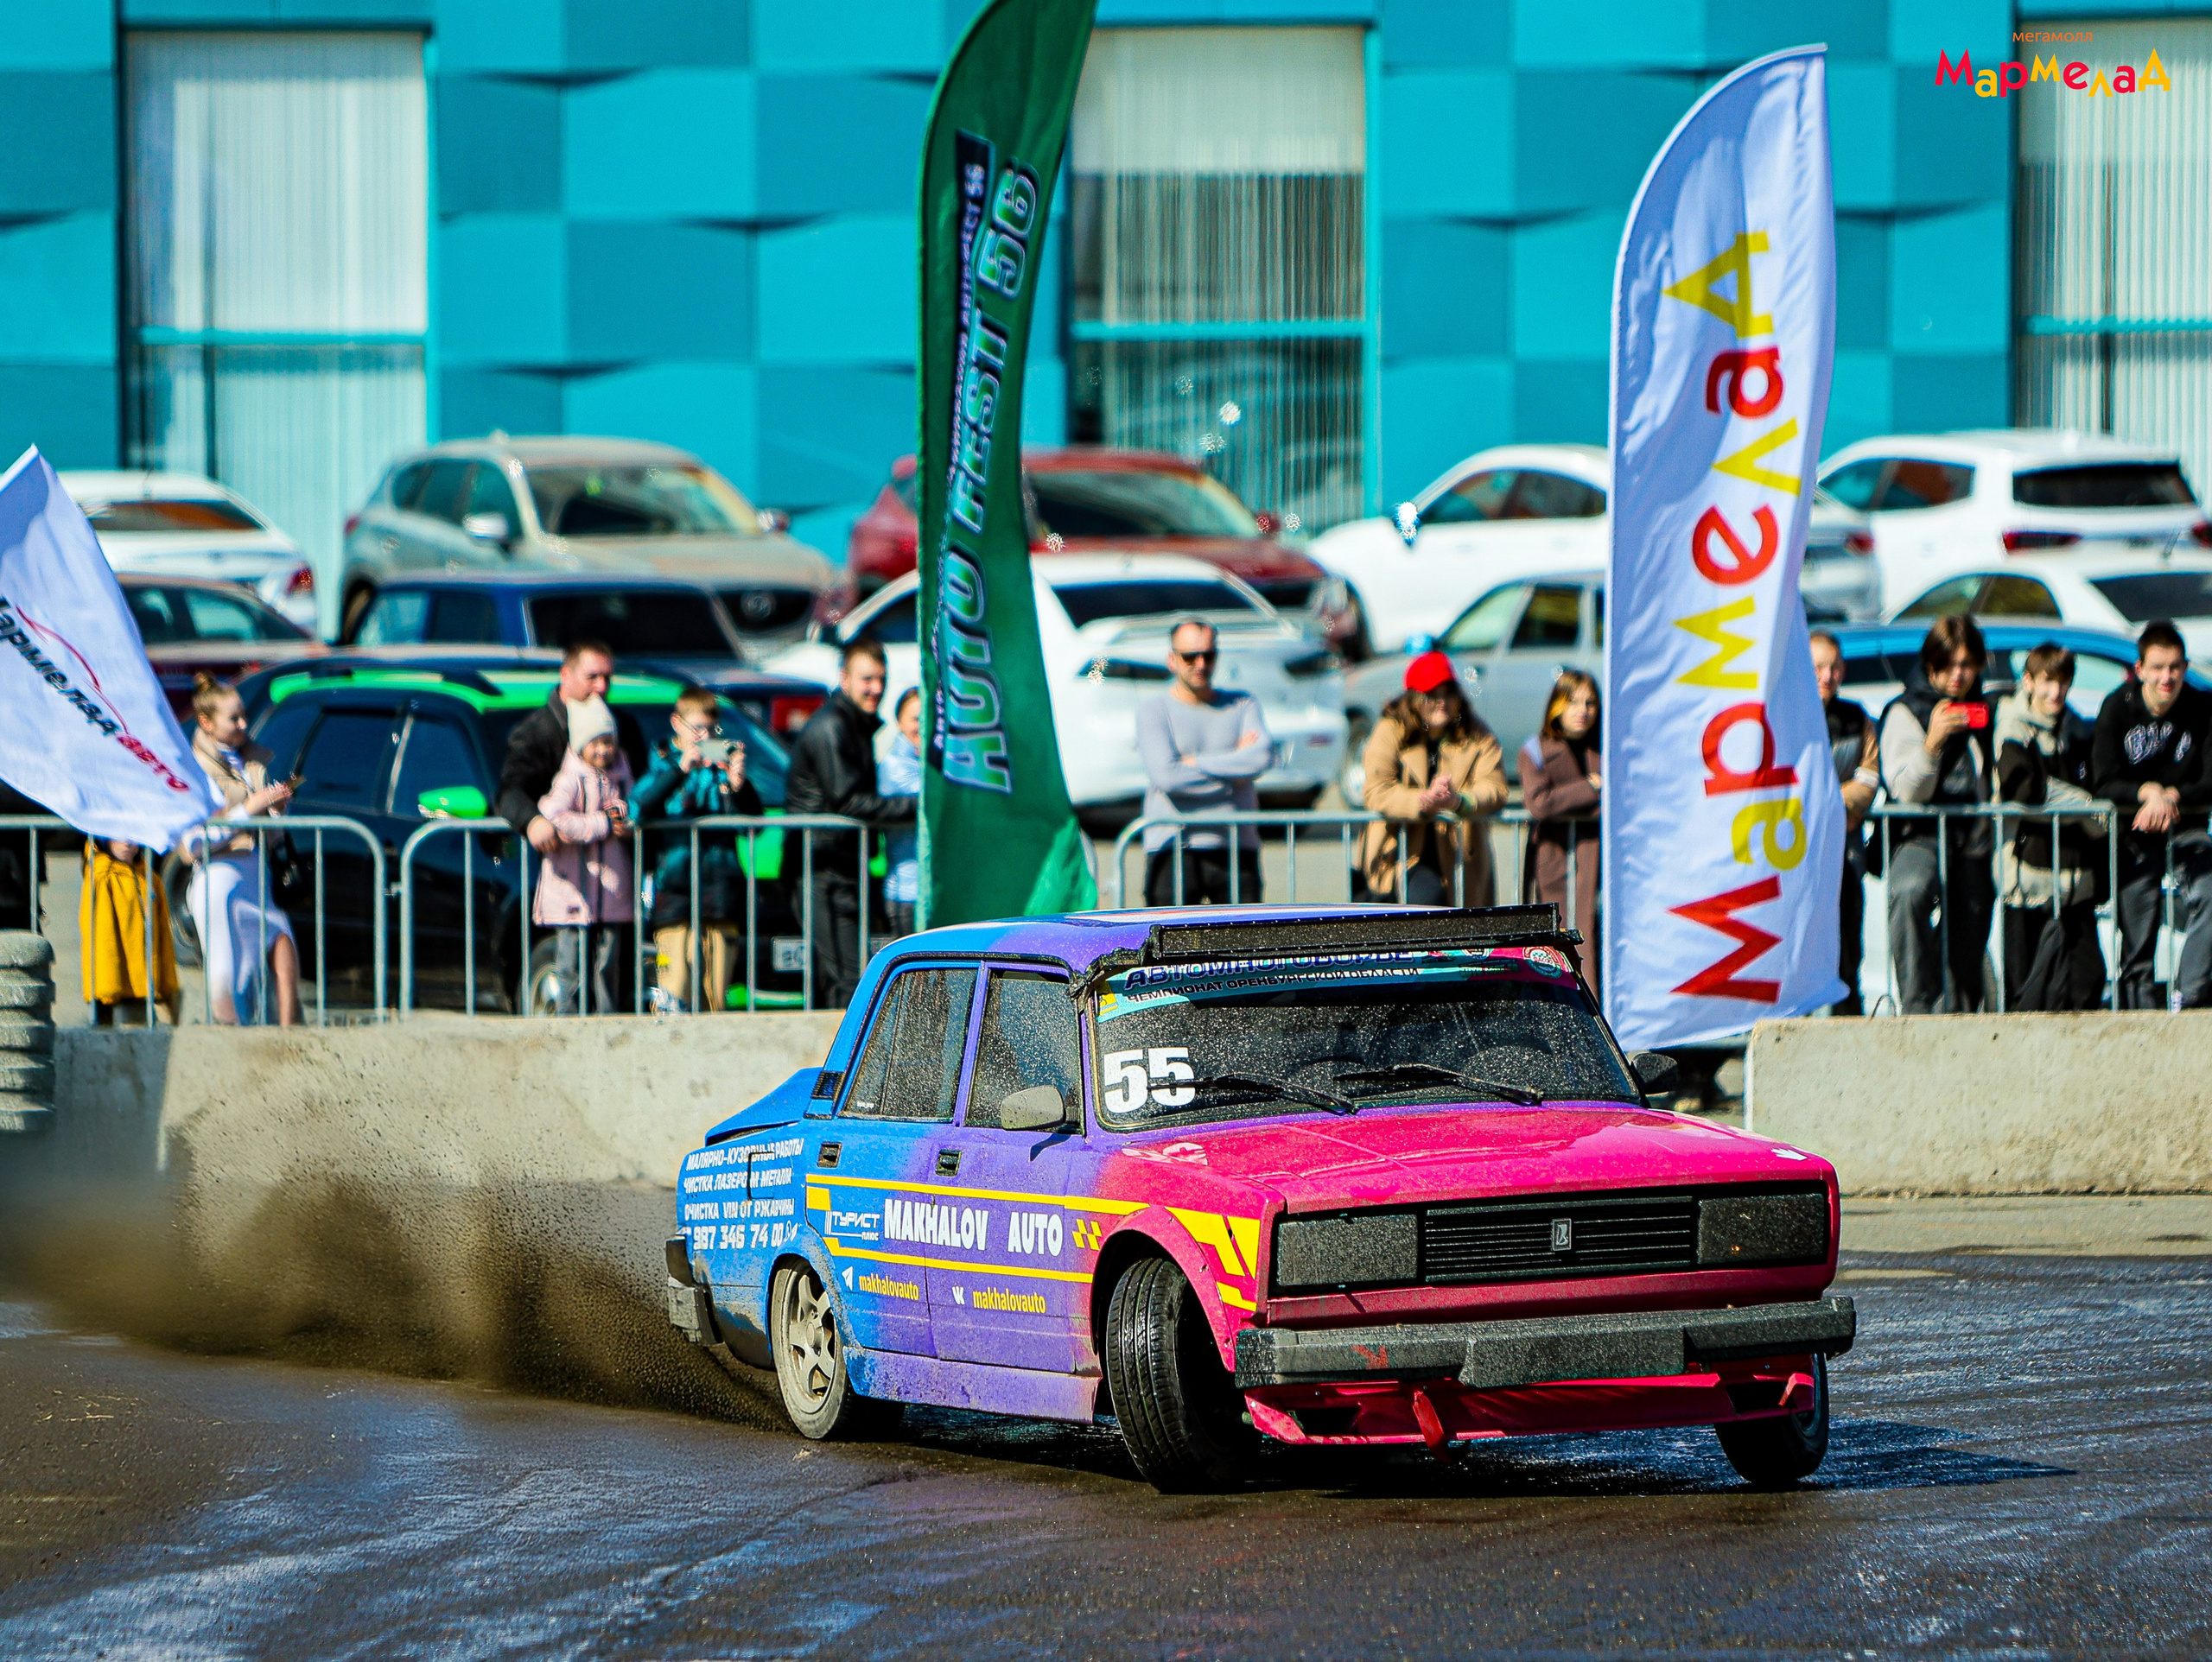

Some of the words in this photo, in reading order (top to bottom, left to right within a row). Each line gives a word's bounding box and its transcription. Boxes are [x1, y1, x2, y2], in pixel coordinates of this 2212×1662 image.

[976, 168, 1040, 299] 56
[942, 548, 1013, 794] AUTO
[1127, 980, 1224, 1004] ЧЕМПИОНАТ
[1225, 968, 1345, 989] ОРЕНБУРГСКОЙ
[1348, 967, 1421, 980] ОБЛАСТИ
[1103, 1047, 1197, 1114] 55
[775, 1138, 804, 1158] РАБОТЫ
[683, 1175, 714, 1194] ЧИСТКА
[684, 1202, 719, 1221] ОЧИСТКА
[723, 1201, 739, 1219] VIN
[739, 1199, 753, 1218] ОТ
[754, 1198, 795, 1217] РЖАВЧИНЫ
[831, 1210, 880, 1228] ТУРИСТ
[693, 1225, 716, 1250] 987
[719, 1224, 746, 1250] 346
[750, 1223, 769, 1249] 74
[771, 1222, 785, 1247] 00
[884, 1198, 989, 1251] MAKHALOV
[1007, 1211, 1064, 1257] AUTO
[859, 1272, 919, 1301] makhalovauto
[972, 1286, 1046, 1314] makhalovauto
